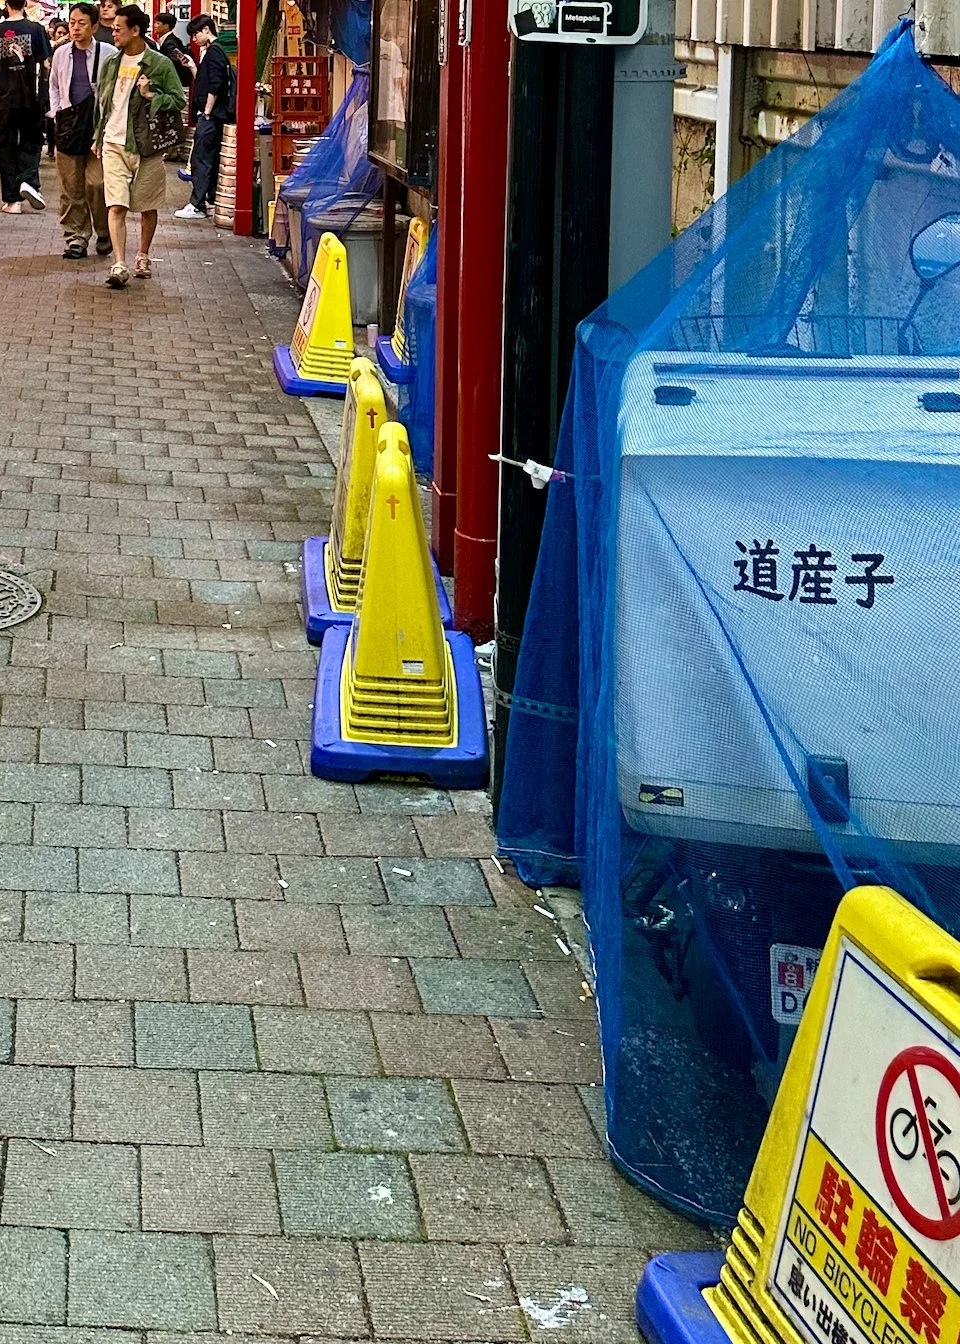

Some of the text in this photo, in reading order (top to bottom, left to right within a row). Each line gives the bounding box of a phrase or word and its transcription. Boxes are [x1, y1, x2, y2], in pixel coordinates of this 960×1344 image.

[733, 538, 895, 609] 道産子
[794, 1215, 818, 1257] NO
[815, 1160, 960, 1344] 駐輪禁
[788, 1262, 858, 1344] 思い出横
